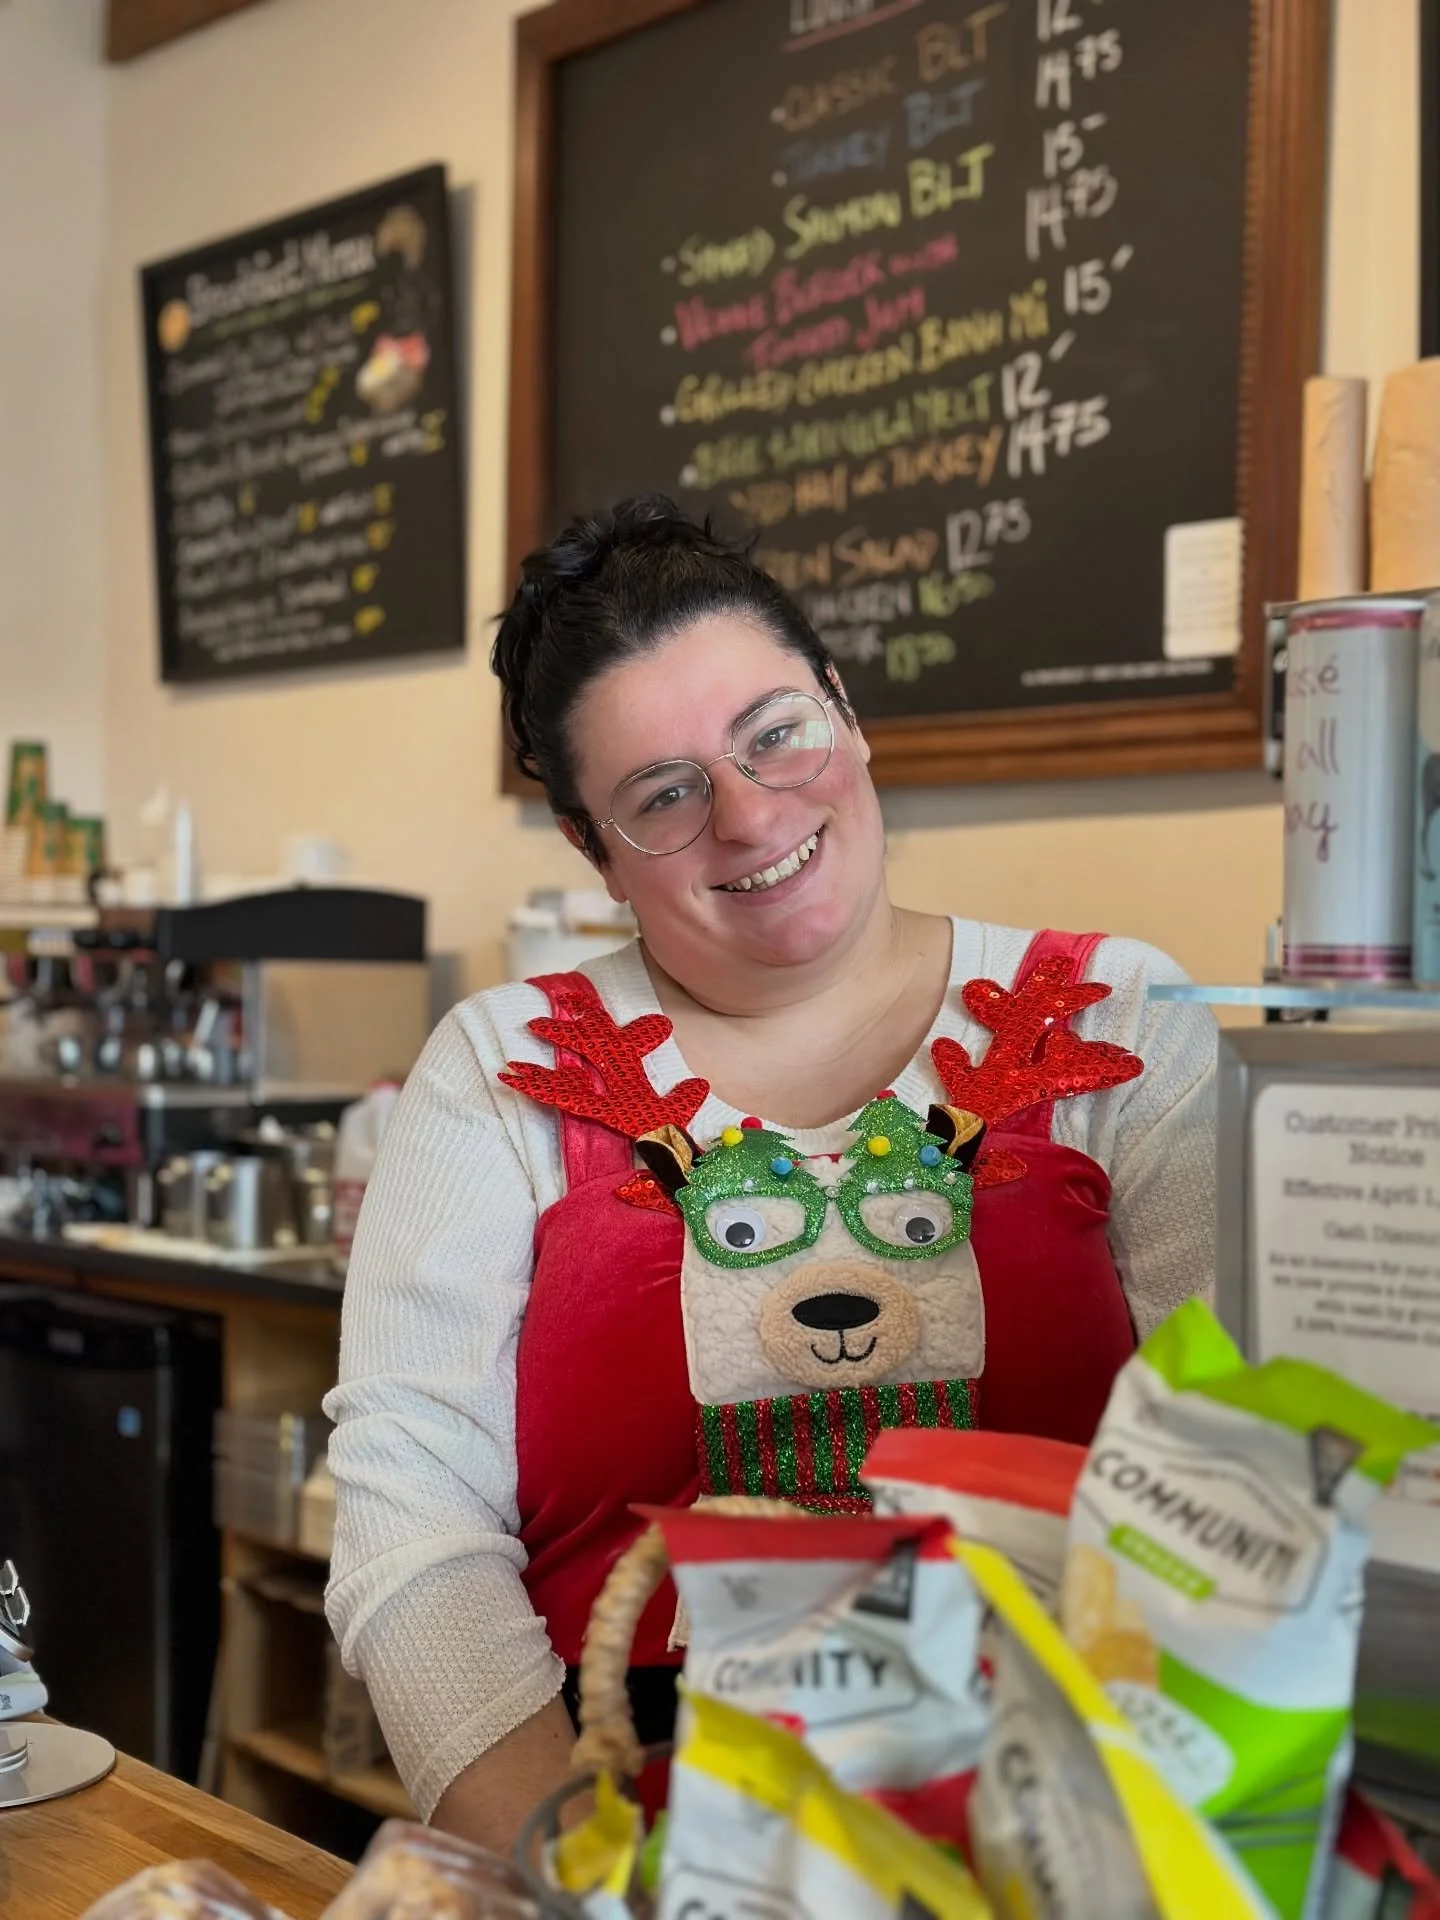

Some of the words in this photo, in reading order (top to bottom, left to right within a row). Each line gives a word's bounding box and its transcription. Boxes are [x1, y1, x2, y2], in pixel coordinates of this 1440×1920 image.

[914, 2, 1007, 82] BLT
[904, 78, 986, 149] BLT
[906, 142, 996, 218] BLT
[1283, 1109, 1398, 1137] Customer
[1349, 1141, 1425, 1167] Notice
[1282, 1177, 1363, 1201] Effective
[1368, 1182, 1419, 1209] April
